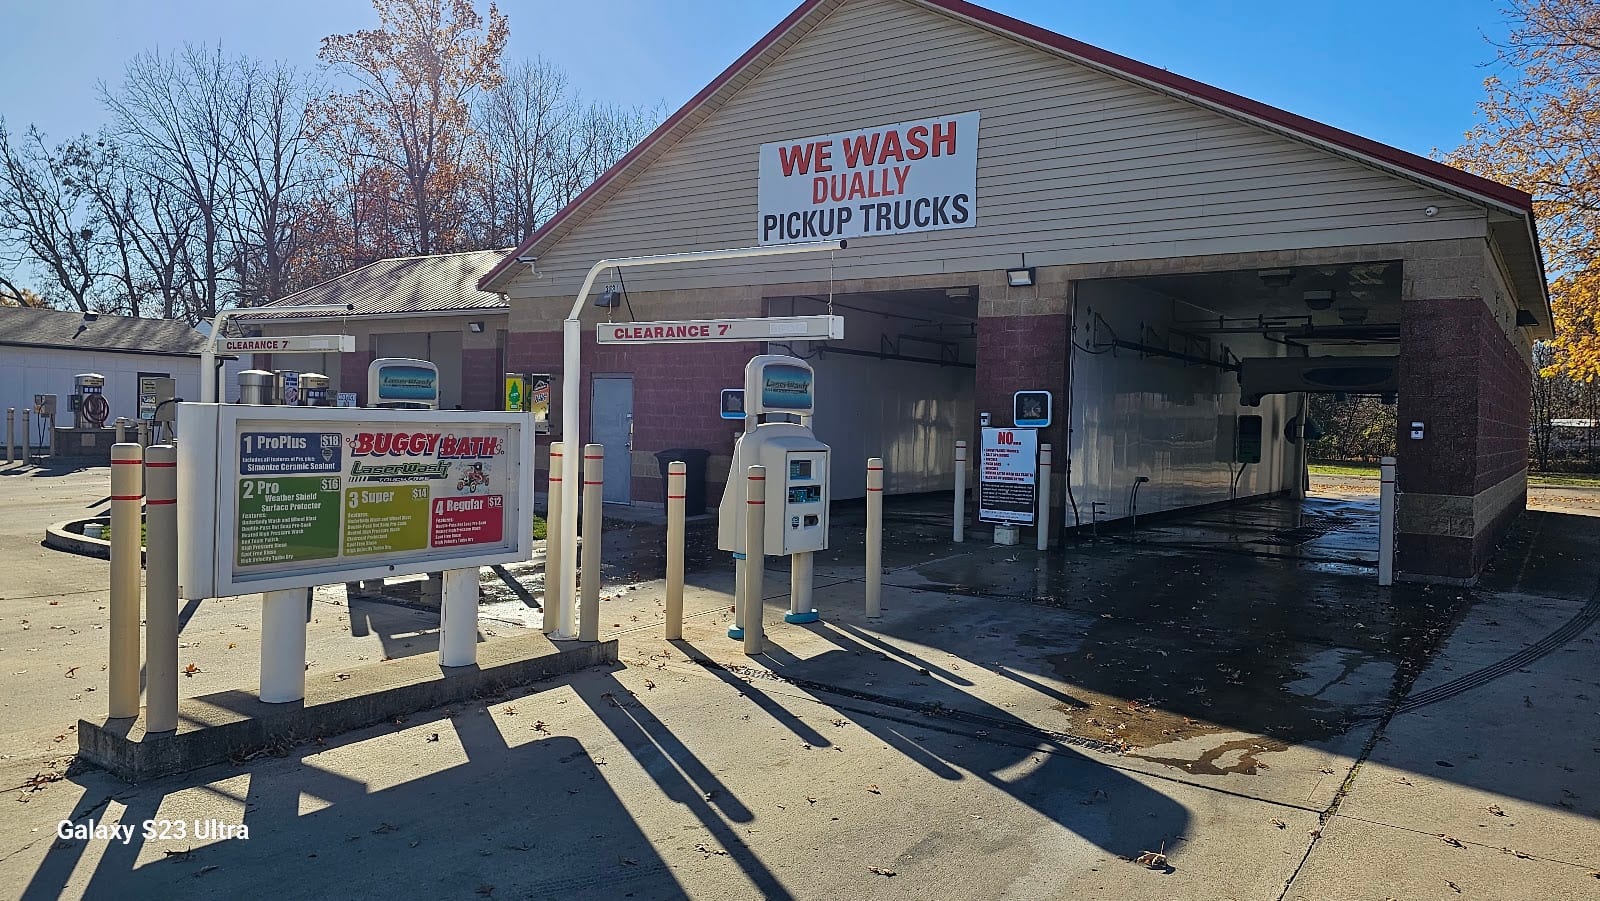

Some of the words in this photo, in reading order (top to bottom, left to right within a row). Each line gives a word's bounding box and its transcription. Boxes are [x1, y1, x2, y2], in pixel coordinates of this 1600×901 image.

[779, 141, 832, 176] WE
[843, 121, 956, 168] WASH
[813, 165, 911, 204] DUALLY
[764, 207, 852, 241] PICKUP
[859, 194, 968, 232] TRUCKS
[614, 325, 710, 340] CLEARANCE
[718, 324, 732, 336] 7'
[226, 341, 278, 350] CLEARANCE
[244, 436, 252, 453] 1
[257, 435, 307, 449] ProPlus
[322, 435, 339, 446] $18
[351, 433, 441, 457] BUGGY
[438, 436, 498, 459] BATH
[311, 462, 335, 470] Sealant
[351, 460, 448, 478] LaserWash
[243, 481, 254, 499] 2
[257, 481, 279, 494] Pro
[322, 479, 338, 490] $16
[265, 494, 294, 502] Weather
[296, 493, 317, 501] Shield
[349, 492, 358, 508] 3
[362, 491, 394, 504] Super
[490, 497, 501, 507] $12
[262, 504, 289, 512] Surface
[290, 502, 321, 510] Protector
[435, 500, 444, 515] 4
[447, 499, 484, 512] Regular
